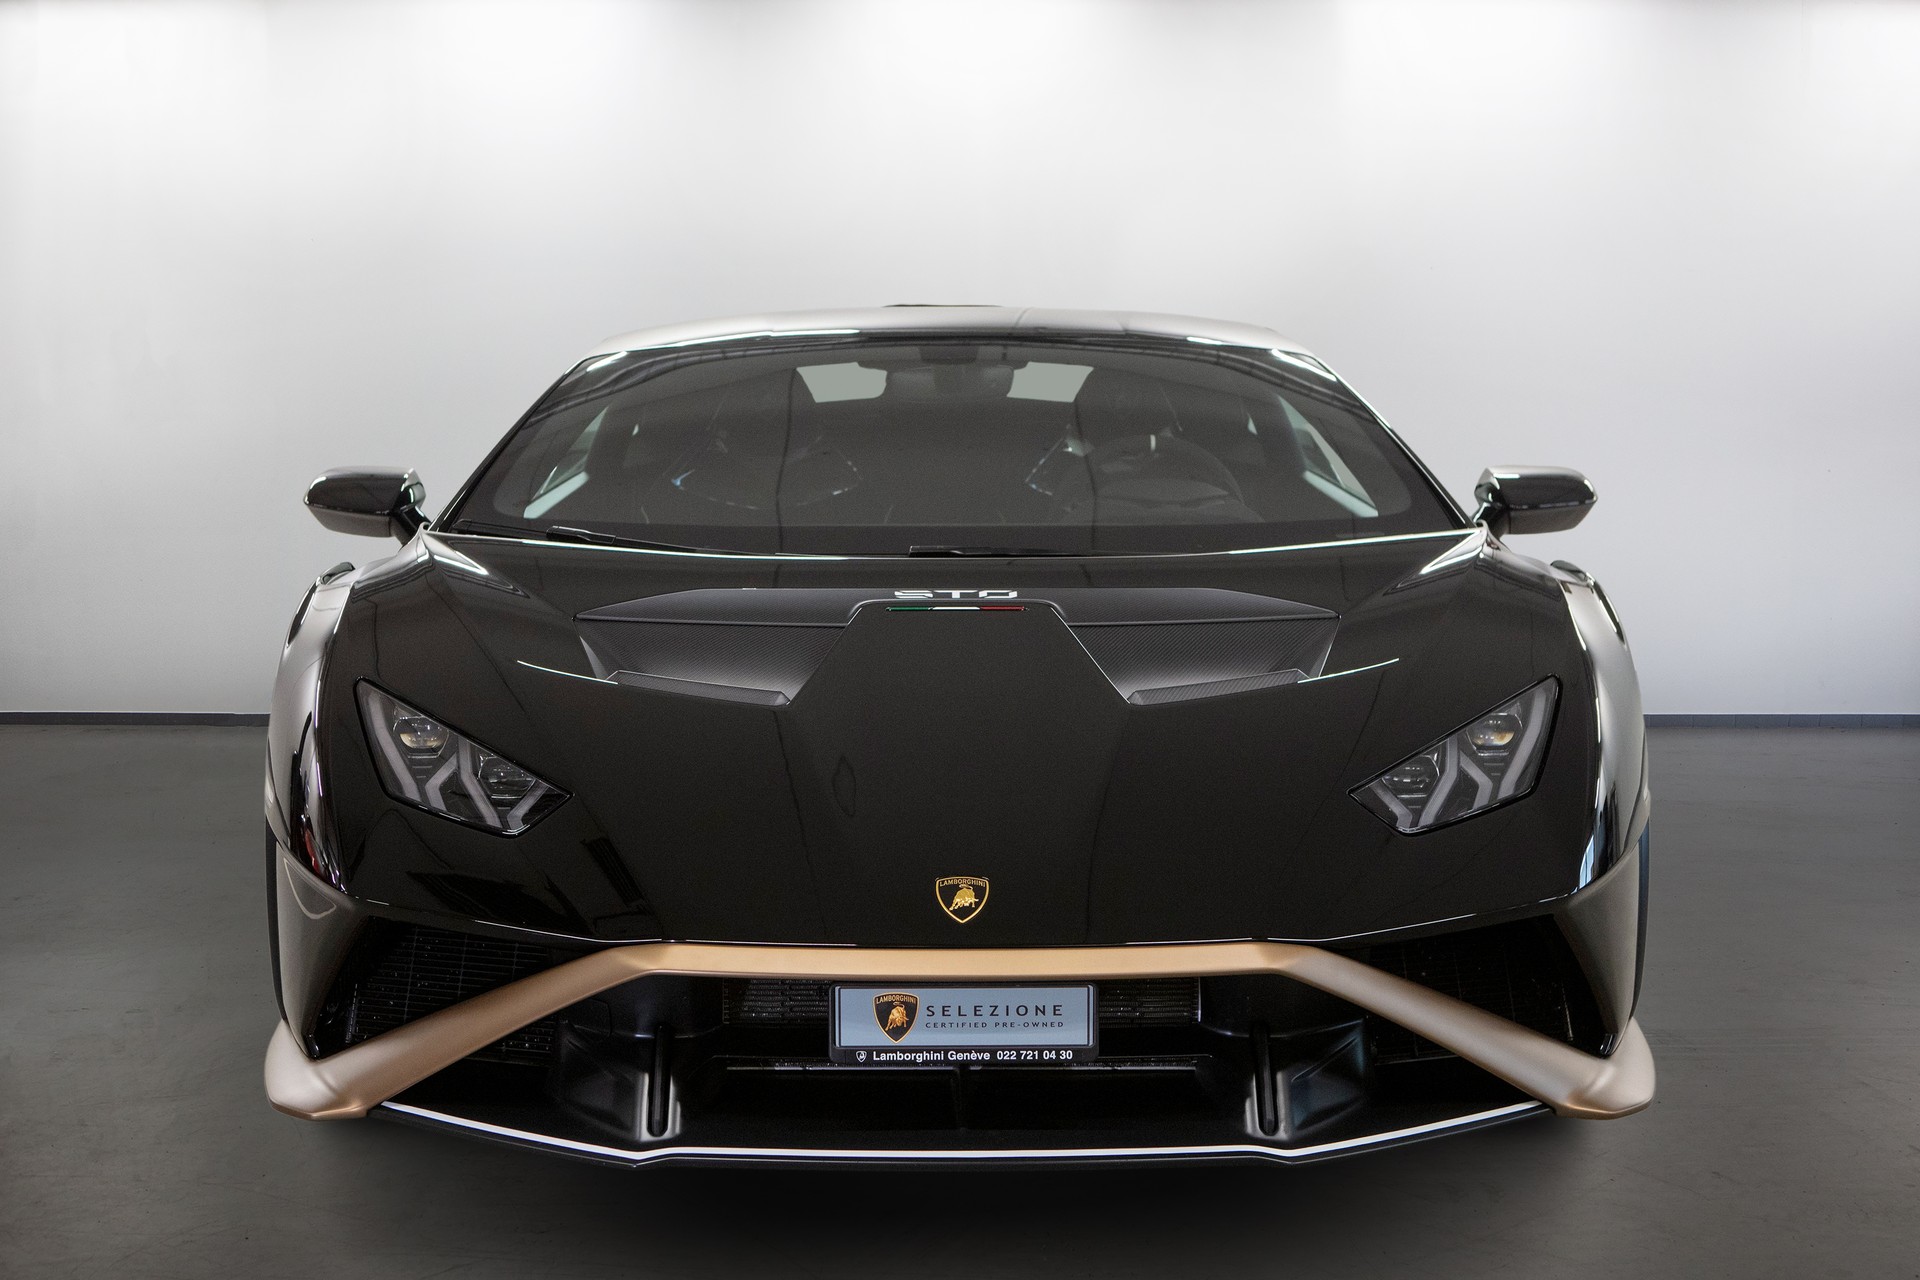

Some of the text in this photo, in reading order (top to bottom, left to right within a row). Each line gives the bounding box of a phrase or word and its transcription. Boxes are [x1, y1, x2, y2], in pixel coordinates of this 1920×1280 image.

[894, 589, 1018, 599] STO
[940, 879, 985, 887] LAMBORGHINI
[876, 995, 917, 1004] LAMBORGHINI
[926, 1005, 1063, 1017] SELEZIONE
[872, 1050, 1073, 1063] Lamborghini Genève 022 721 04 30
